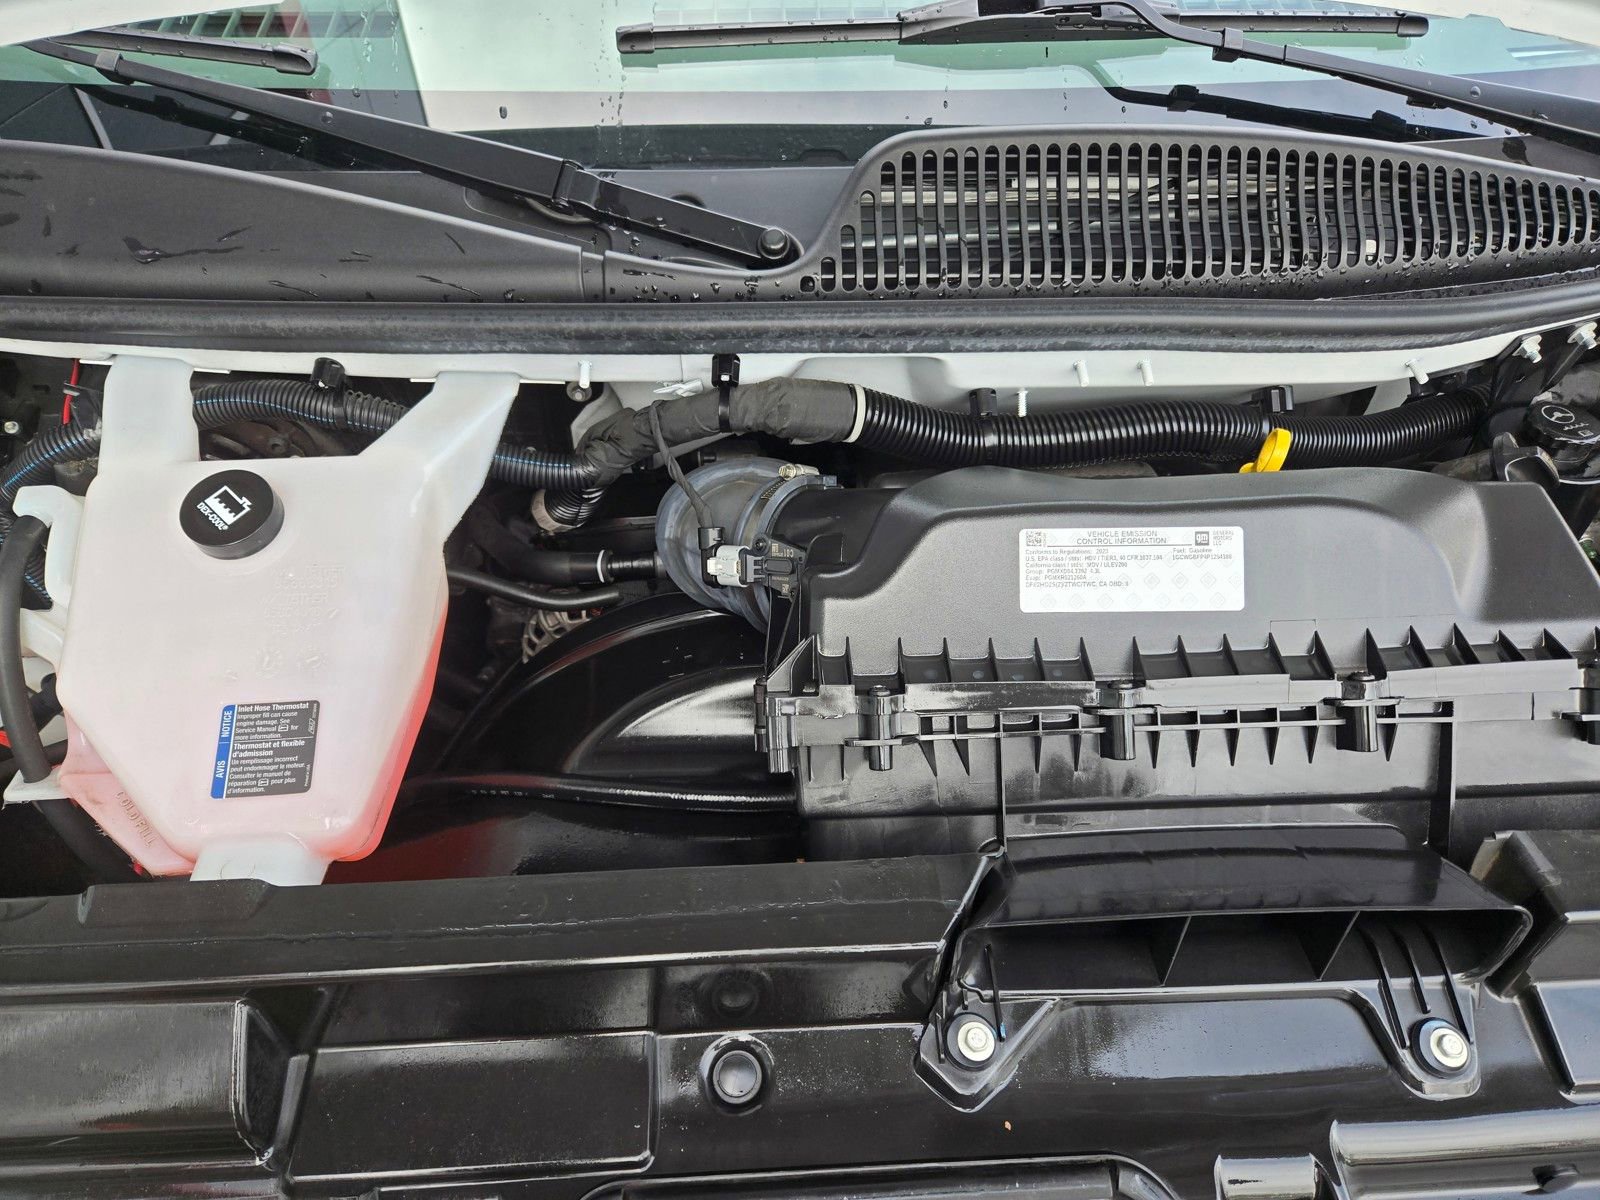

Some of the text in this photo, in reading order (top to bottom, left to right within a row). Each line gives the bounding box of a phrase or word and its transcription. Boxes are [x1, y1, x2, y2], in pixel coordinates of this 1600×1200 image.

[272, 702, 309, 710] Thermostat
[221, 710, 232, 737] NOTICE
[234, 742, 272, 750] Thermostat
[216, 760, 225, 778] AVIS
